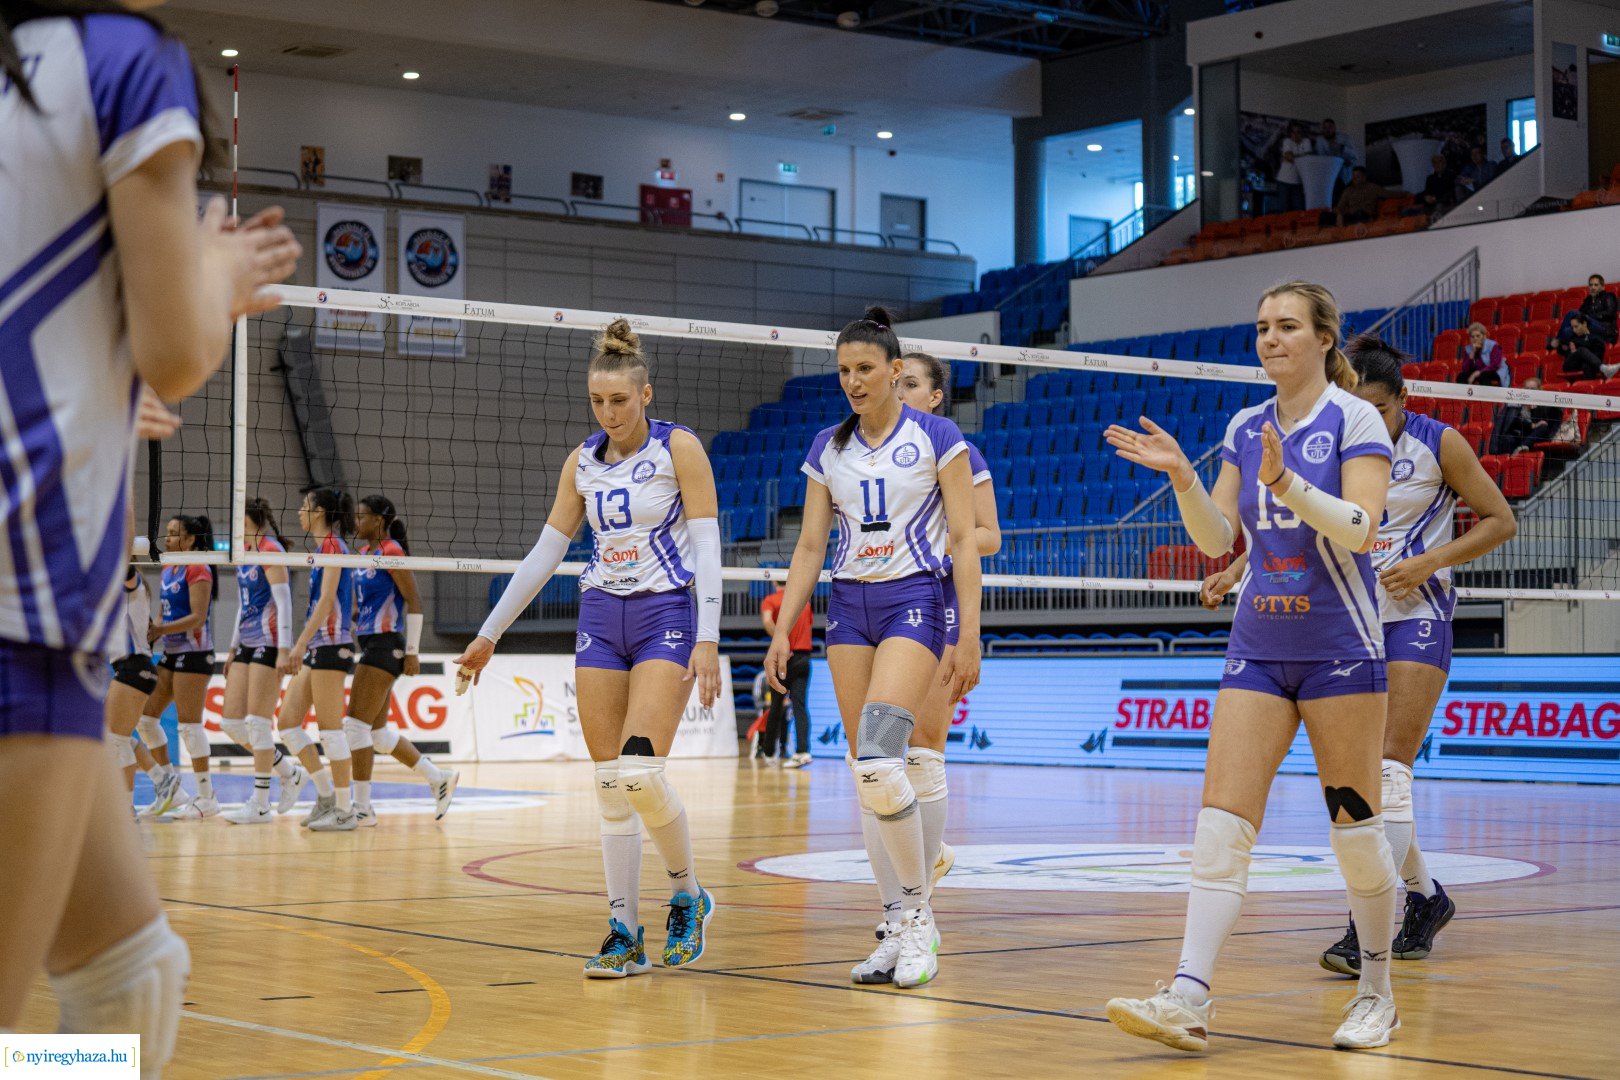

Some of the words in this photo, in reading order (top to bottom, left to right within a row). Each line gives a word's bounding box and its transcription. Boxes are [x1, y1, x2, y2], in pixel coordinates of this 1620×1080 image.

[464, 303, 495, 317] FATUM
[688, 322, 717, 334] FATUM
[1084, 356, 1108, 367] FATUM
[1255, 370, 1267, 380] FAT
[1412, 383, 1432, 393] FATUM
[1554, 395, 1573, 404] FATUM
[859, 477, 888, 522] 11
[595, 487, 633, 532] 13
[1352, 510, 1363, 525] PB
[603, 545, 639, 563] Capri
[857, 540, 894, 557] Capri
[456, 561, 482, 570] FATUM
[907, 608, 923, 622] 11
[1418, 620, 1432, 638] 3
[1115, 697, 1210, 730] STRAB
[1442, 700, 1620, 740] STRABAG
